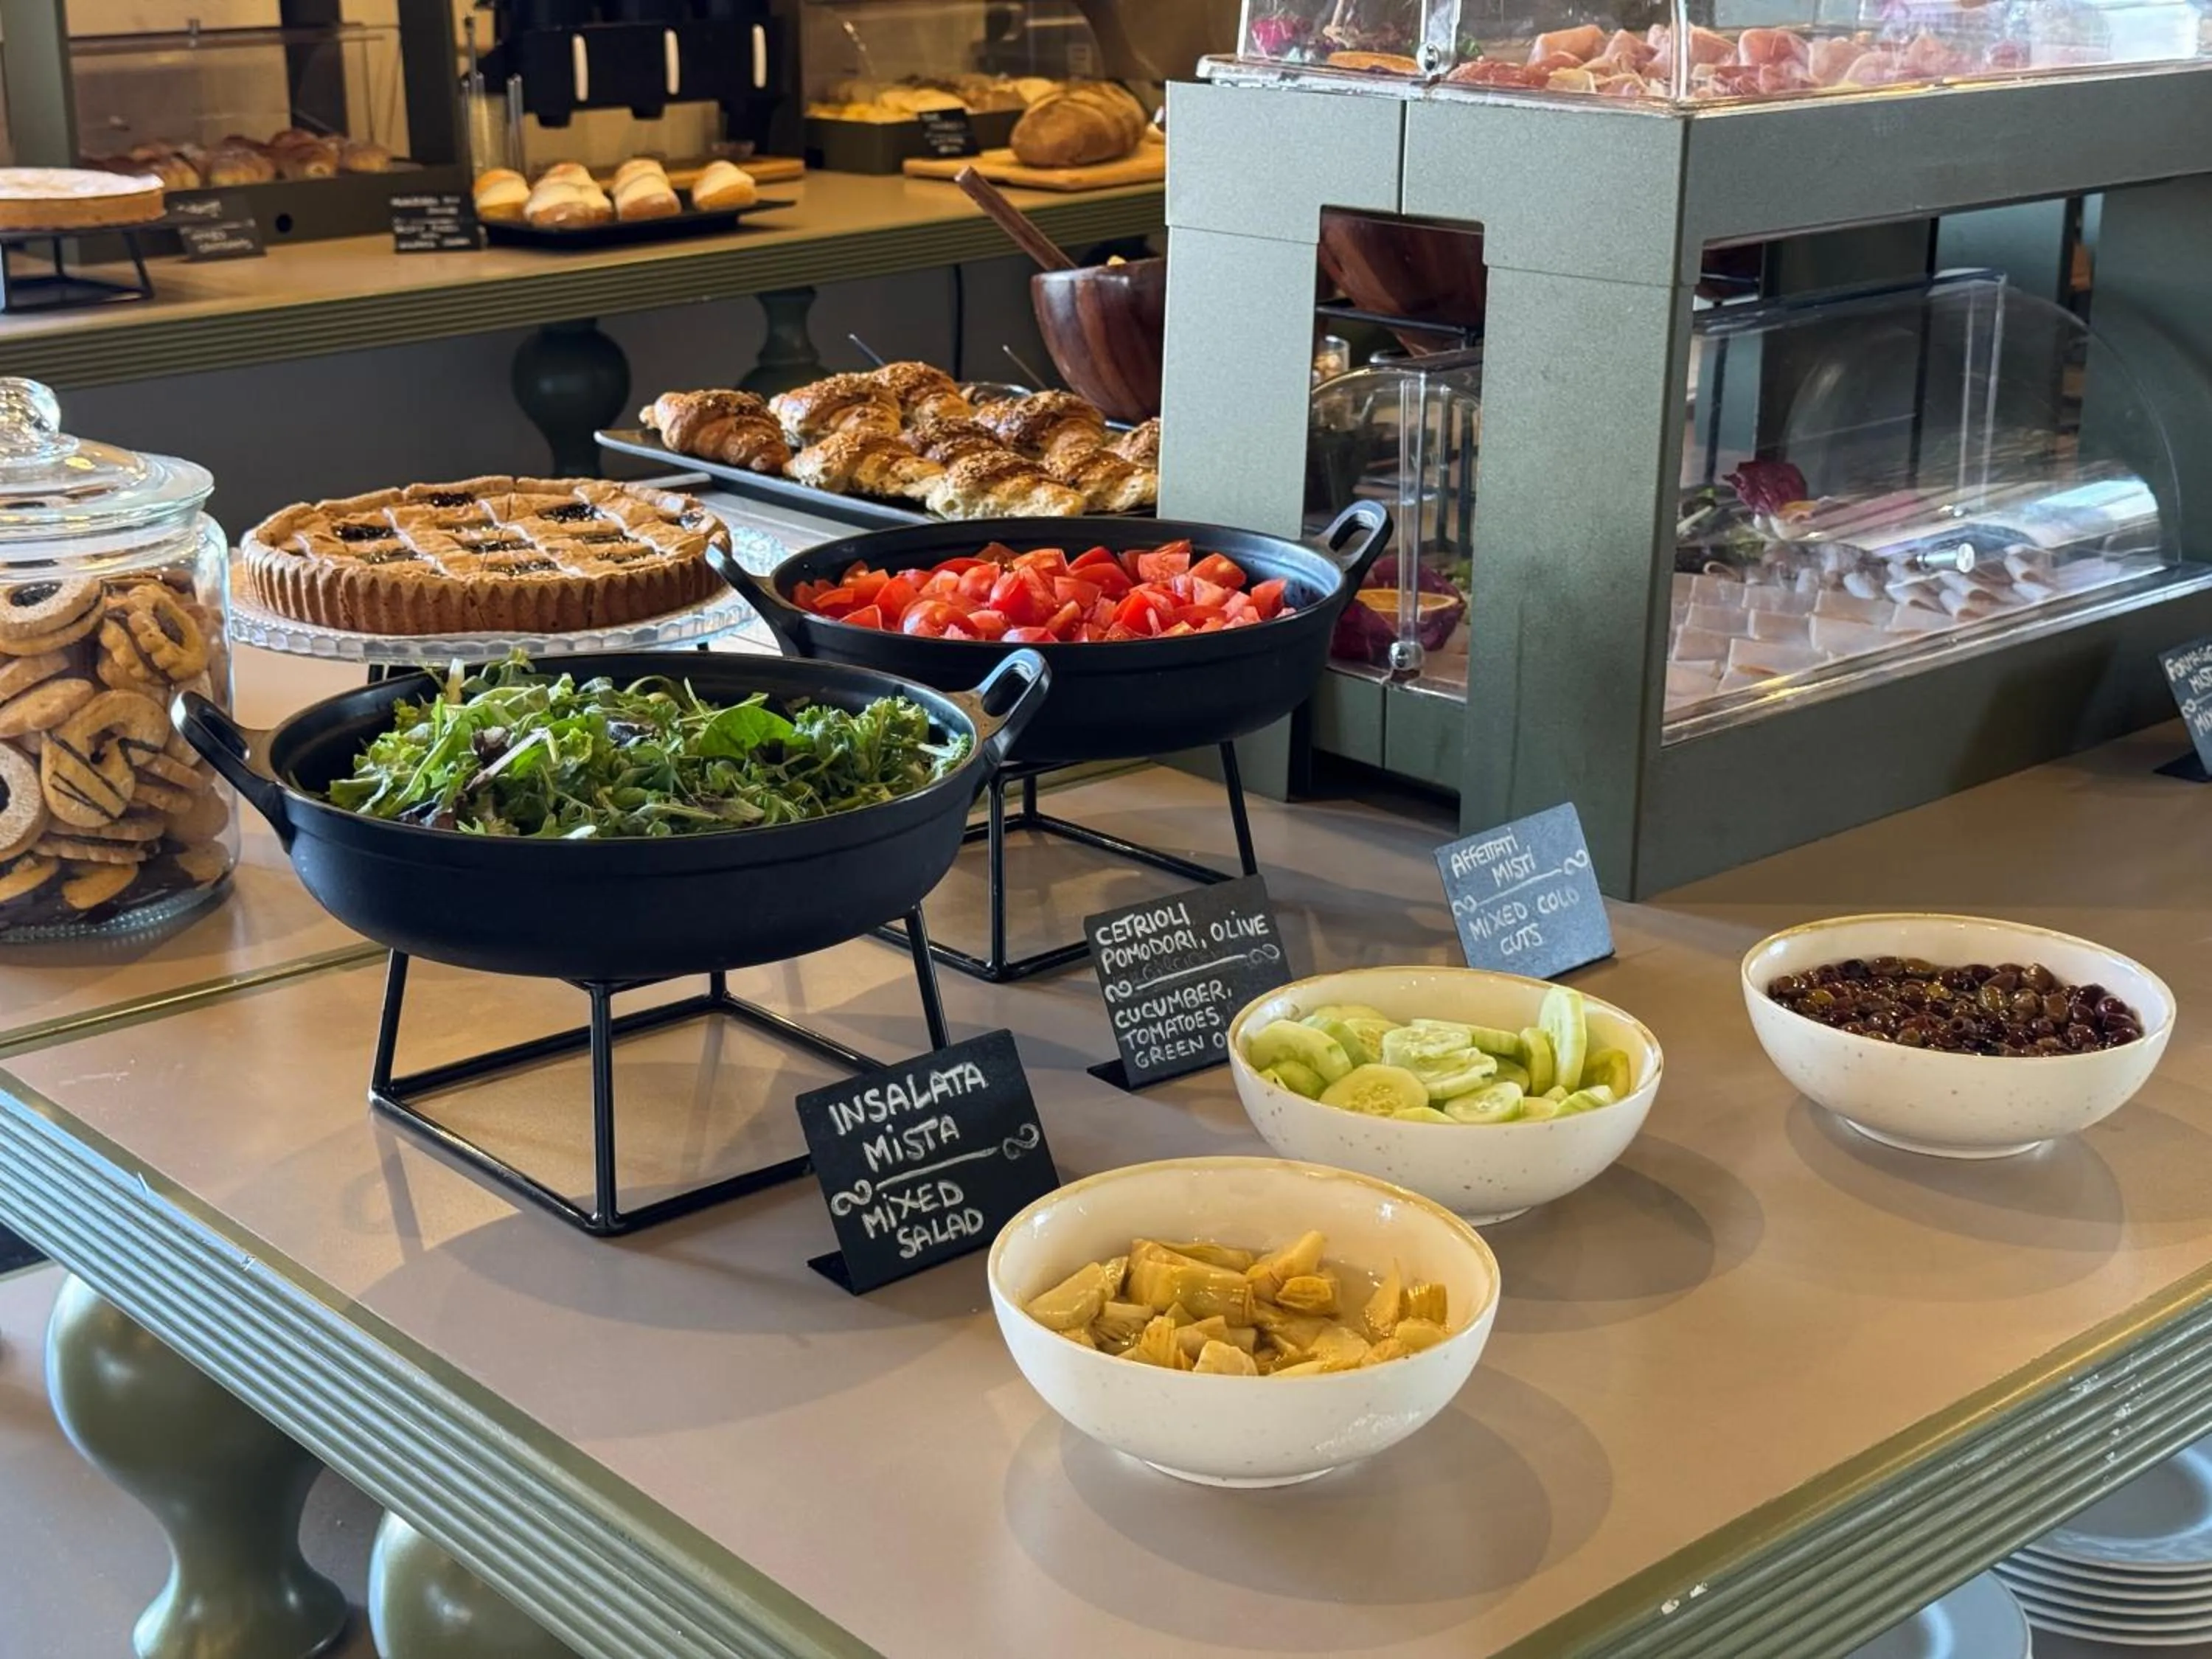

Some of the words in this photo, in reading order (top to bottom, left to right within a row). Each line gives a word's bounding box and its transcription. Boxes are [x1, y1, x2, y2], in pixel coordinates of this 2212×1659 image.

[1537, 888, 1580, 914] COLD
[1096, 902, 1191, 945] CETRIOLI
[1500, 923, 1544, 955] CUTS
[1100, 929, 1207, 974] POMODORI,
[1114, 979, 1232, 1029] CUCUMBER,
[1135, 1036, 1205, 1069] GREEN
[828, 1062, 989, 1135] INSALATA
[896, 1208, 984, 1259] SALAD
